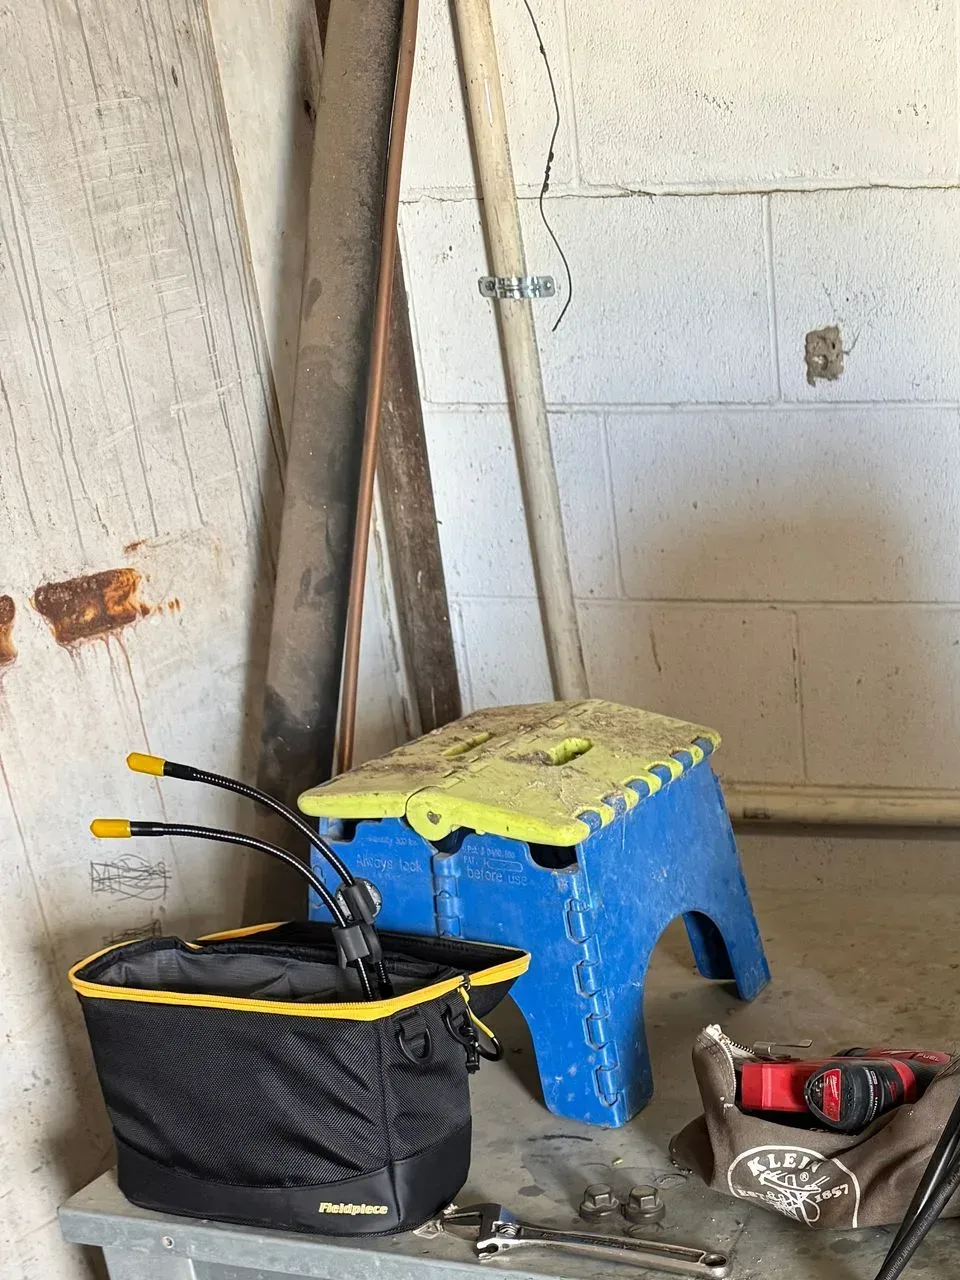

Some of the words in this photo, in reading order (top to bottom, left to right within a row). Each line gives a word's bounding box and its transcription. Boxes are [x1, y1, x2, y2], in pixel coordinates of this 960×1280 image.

[356, 853, 394, 872] Always
[400, 857, 424, 873] look
[466, 865, 503, 883] before
[507, 873, 528, 887] use
[815, 1184, 852, 1205] 1857
[318, 1202, 388, 1215] Fieldpiece
